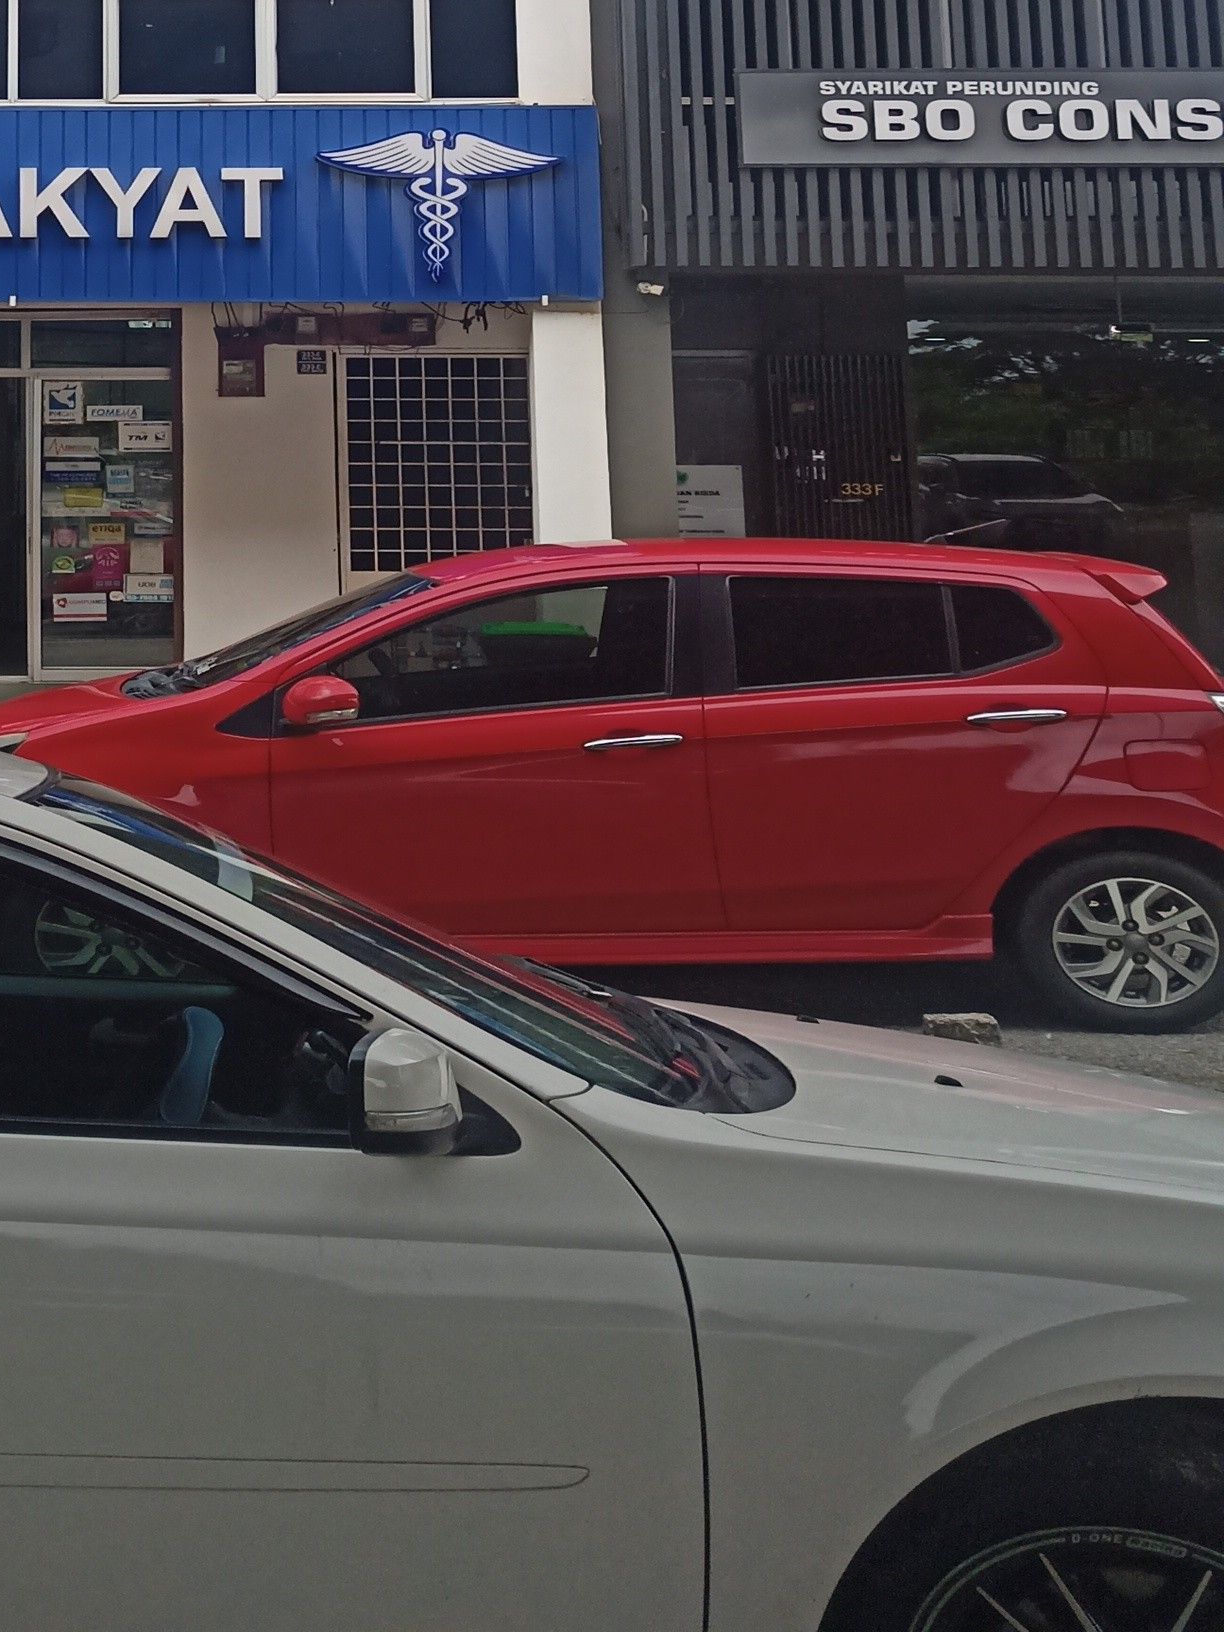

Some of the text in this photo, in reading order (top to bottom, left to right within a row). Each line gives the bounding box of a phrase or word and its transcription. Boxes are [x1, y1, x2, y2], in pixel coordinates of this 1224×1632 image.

[819, 81, 1099, 96] SYARIKAT PERUNDING
[820, 99, 1224, 142] SBO CONS
[840, 483, 885, 496] 333F
